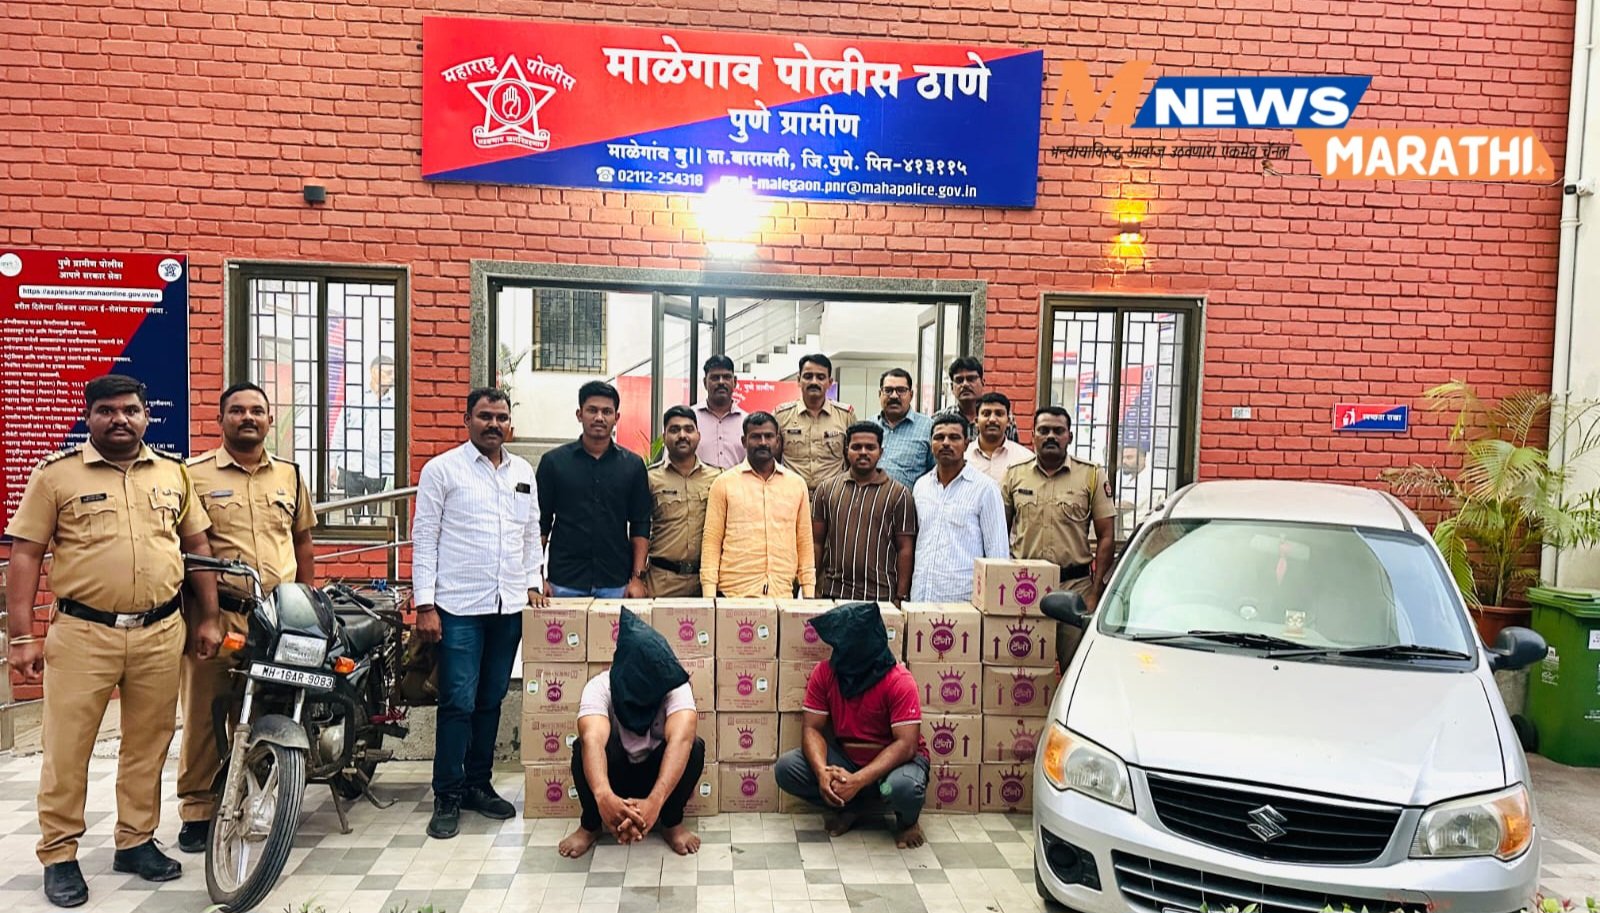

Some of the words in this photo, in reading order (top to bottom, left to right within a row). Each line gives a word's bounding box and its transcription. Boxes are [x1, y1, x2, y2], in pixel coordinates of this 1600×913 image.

[441, 57, 499, 83] महाराष्ट्र
[526, 55, 577, 92] पोलीस
[602, 35, 762, 91] माळेगाव
[774, 43, 902, 99] पोलीस
[913, 52, 991, 102] ठाणे
[728, 100, 771, 143] पुणे
[779, 105, 860, 138] ग्रामीण
[607, 140, 669, 163] माळेगांव
[618, 169, 703, 187] 02112-254318
[57, 257, 71, 270] पुणे
[72, 258, 97, 268] ग्रामीण
[98, 258, 124, 269] पोलीस
[82, 272, 105, 280] सरकार
